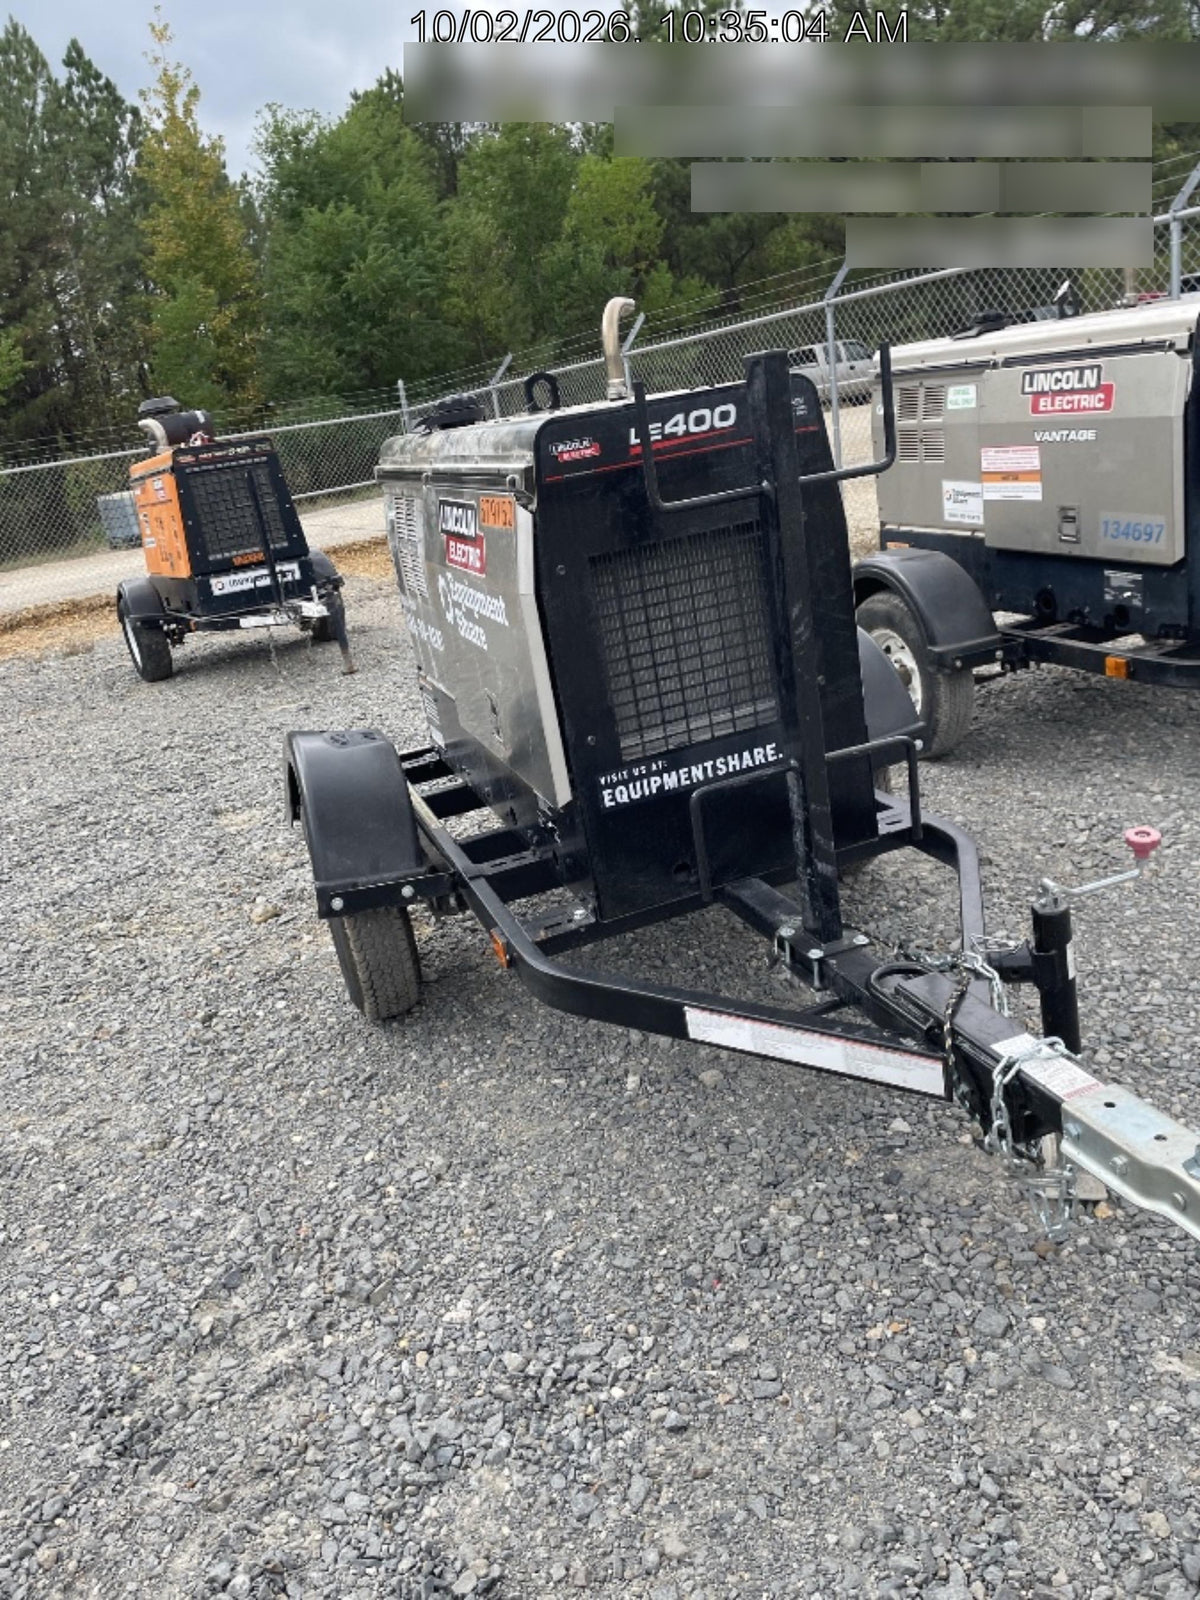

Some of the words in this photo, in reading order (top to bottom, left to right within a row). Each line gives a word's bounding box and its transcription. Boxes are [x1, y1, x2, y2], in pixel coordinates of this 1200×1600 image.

[1024, 368, 1098, 393] LINCOLN
[1038, 393, 1105, 412] ELECTRIC
[1034, 429, 1097, 442] VANTAGE
[440, 504, 476, 538] LINCOLN
[1101, 519, 1165, 543] 134697
[449, 540, 481, 568] ELECTRIC
[599, 769, 628, 785] VISIT
[632, 765, 647, 777] US
